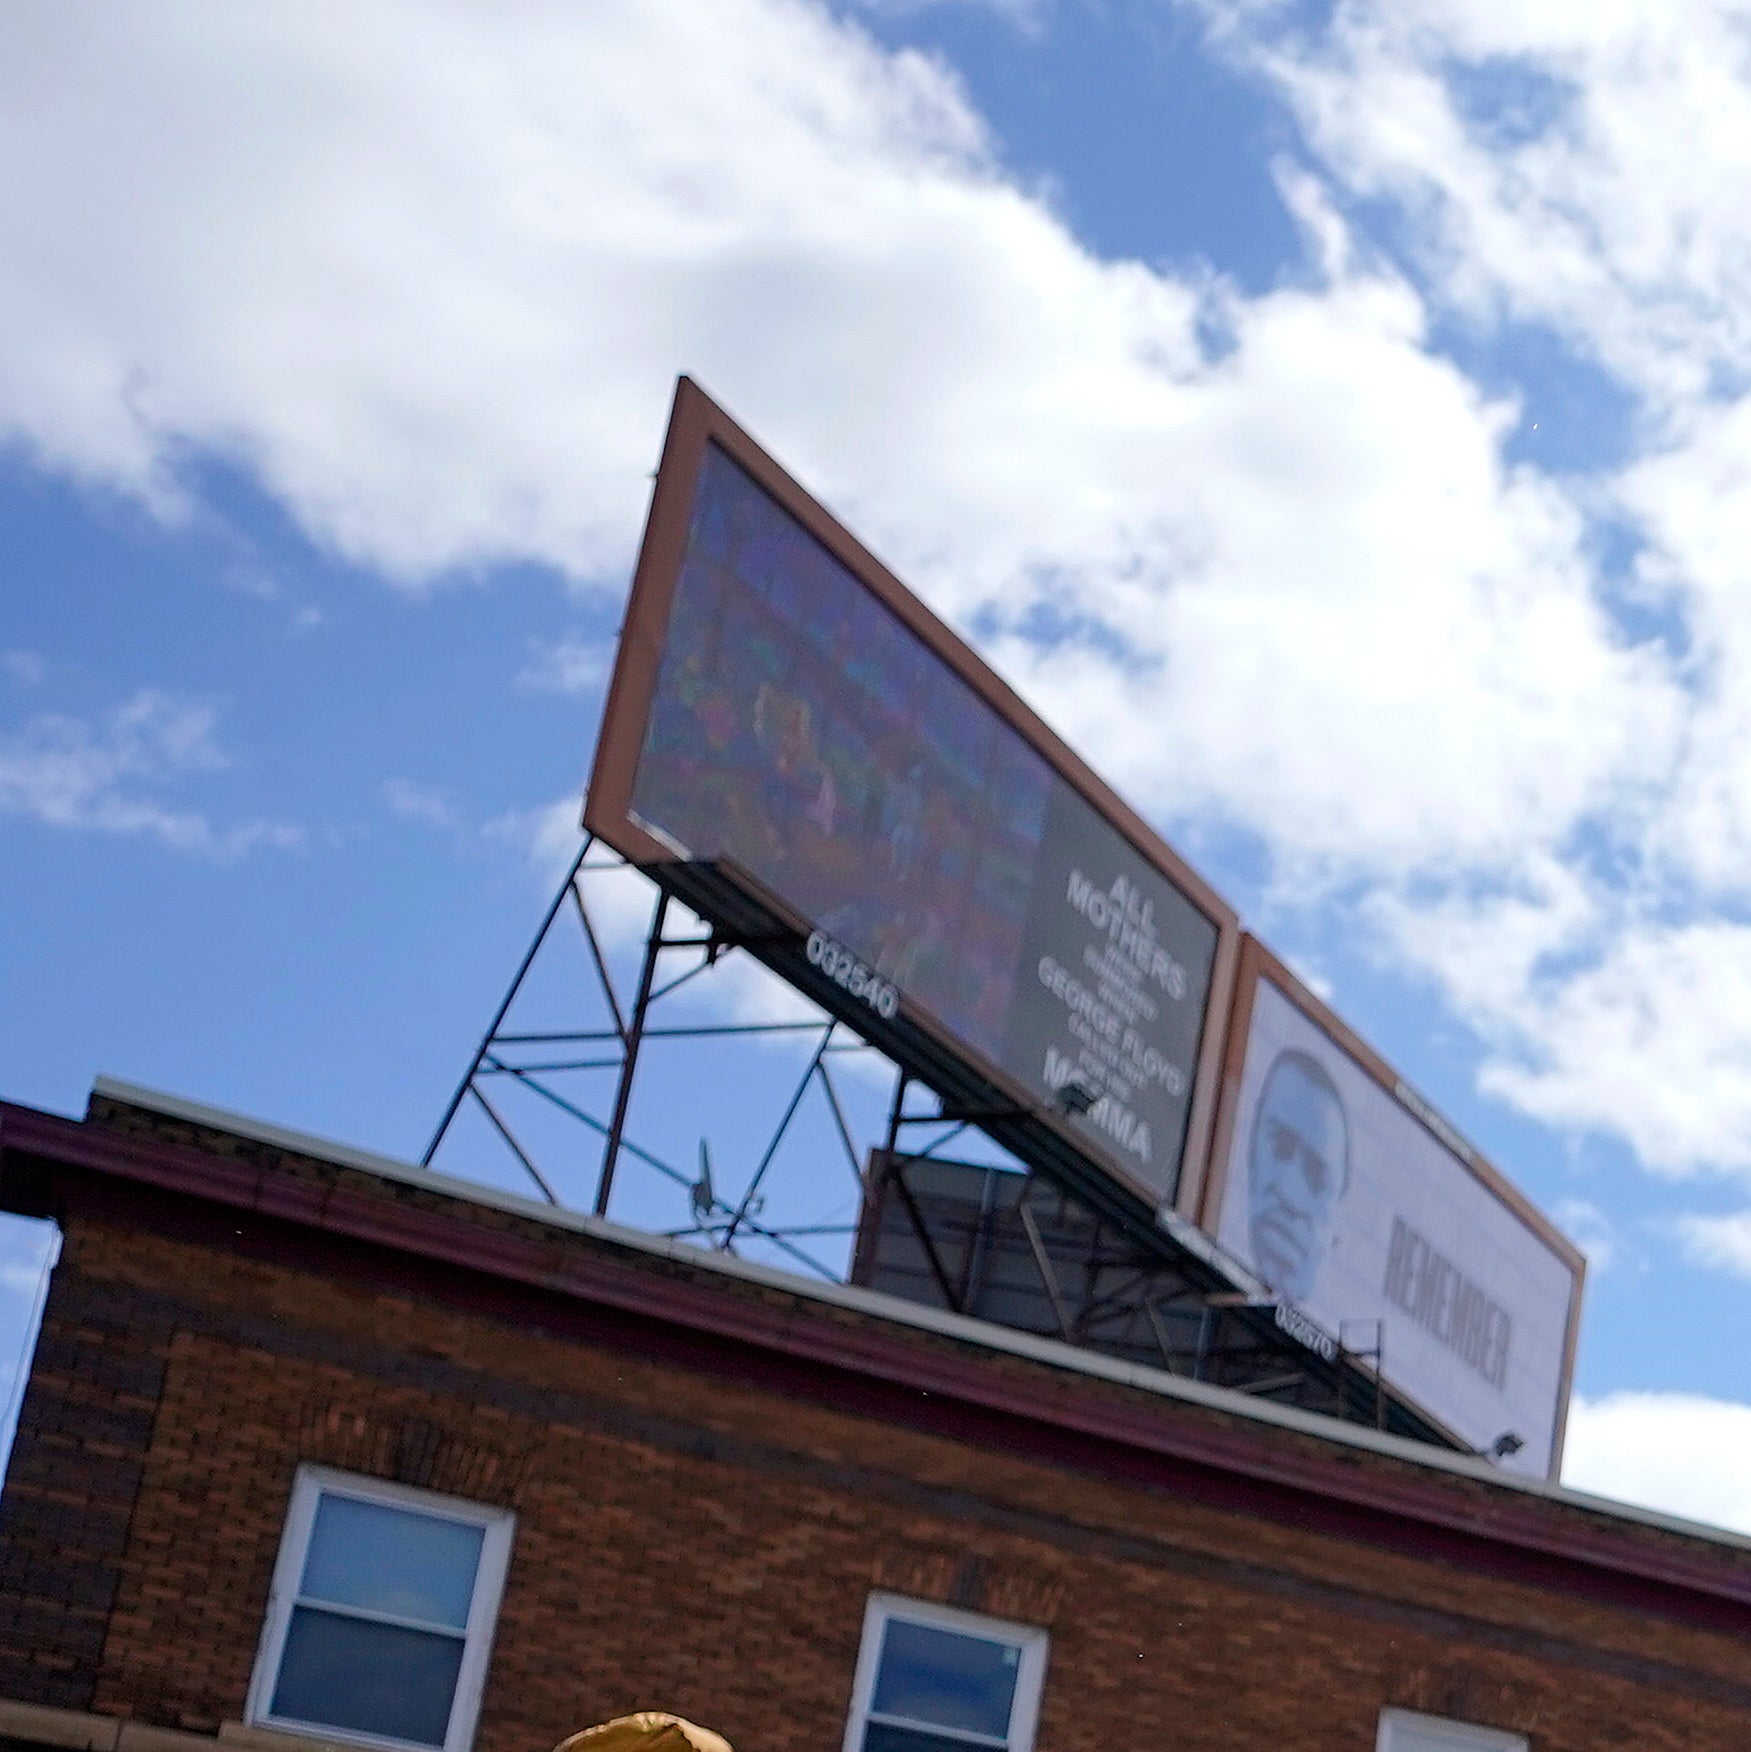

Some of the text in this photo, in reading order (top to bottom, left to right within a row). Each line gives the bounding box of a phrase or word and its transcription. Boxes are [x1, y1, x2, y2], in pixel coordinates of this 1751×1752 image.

[1066, 870, 1187, 1000] MOTHERS
[1109, 875, 1157, 941] ALL
[806, 930, 900, 1019] 032540
[1384, 1213, 1512, 1393] REMEMBER
